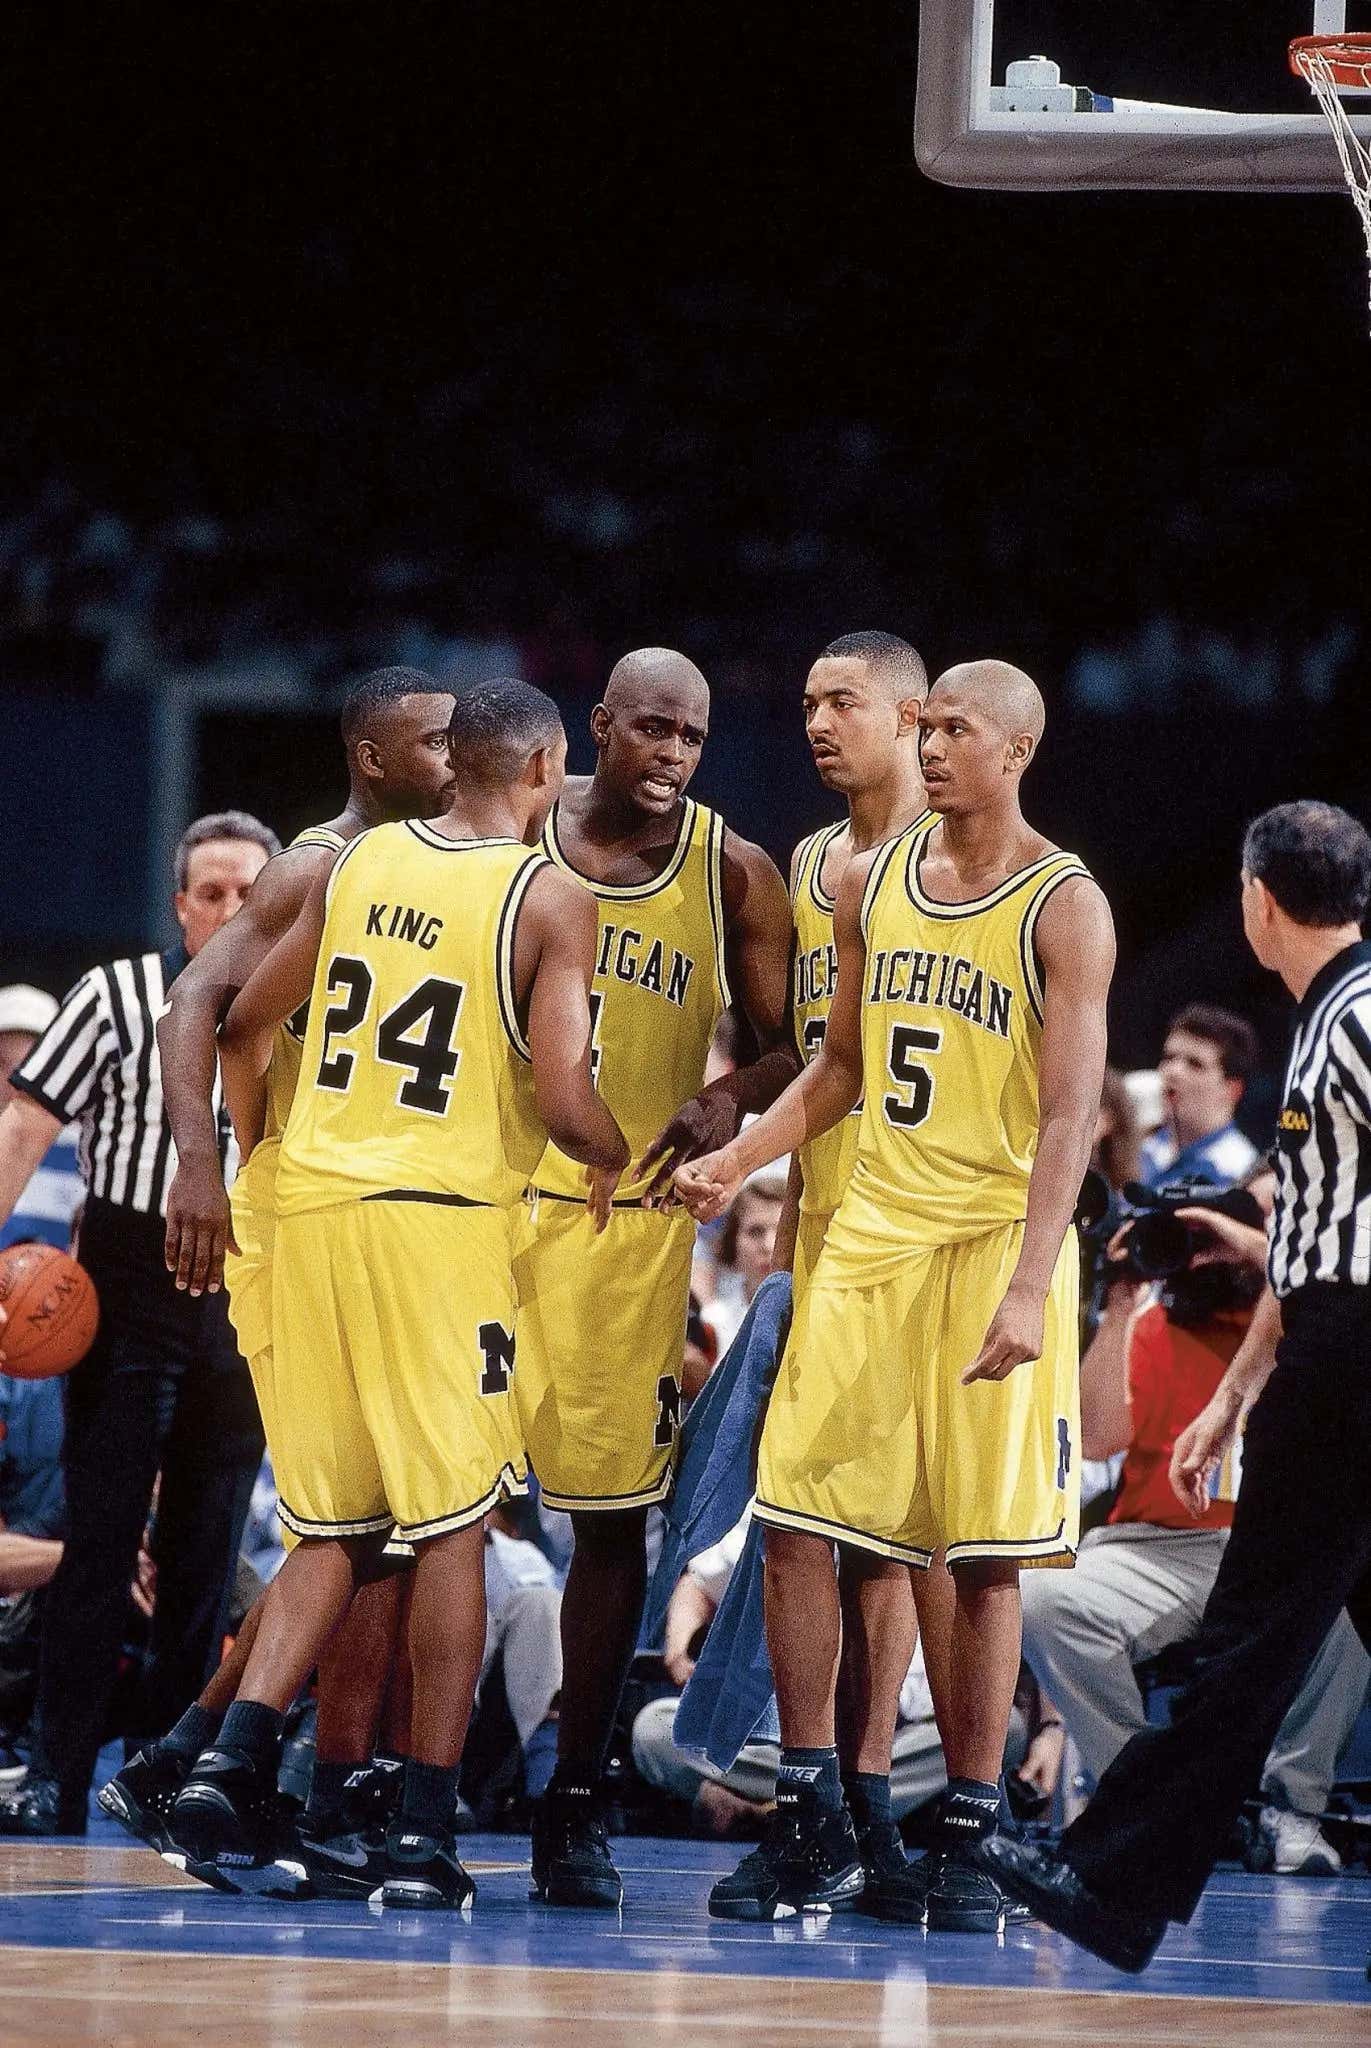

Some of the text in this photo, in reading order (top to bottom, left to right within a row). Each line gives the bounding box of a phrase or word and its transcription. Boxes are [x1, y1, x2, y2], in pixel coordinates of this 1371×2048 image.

[365, 903, 444, 951] KING
[595, 923, 695, 1009] IGAN
[316, 952, 467, 1118] 24
[867, 947, 1014, 1040] ICHIGAN
[882, 1021, 944, 1129] 5
[556, 1786, 592, 1796] AMAX
[778, 1794, 799, 1803] MAX
